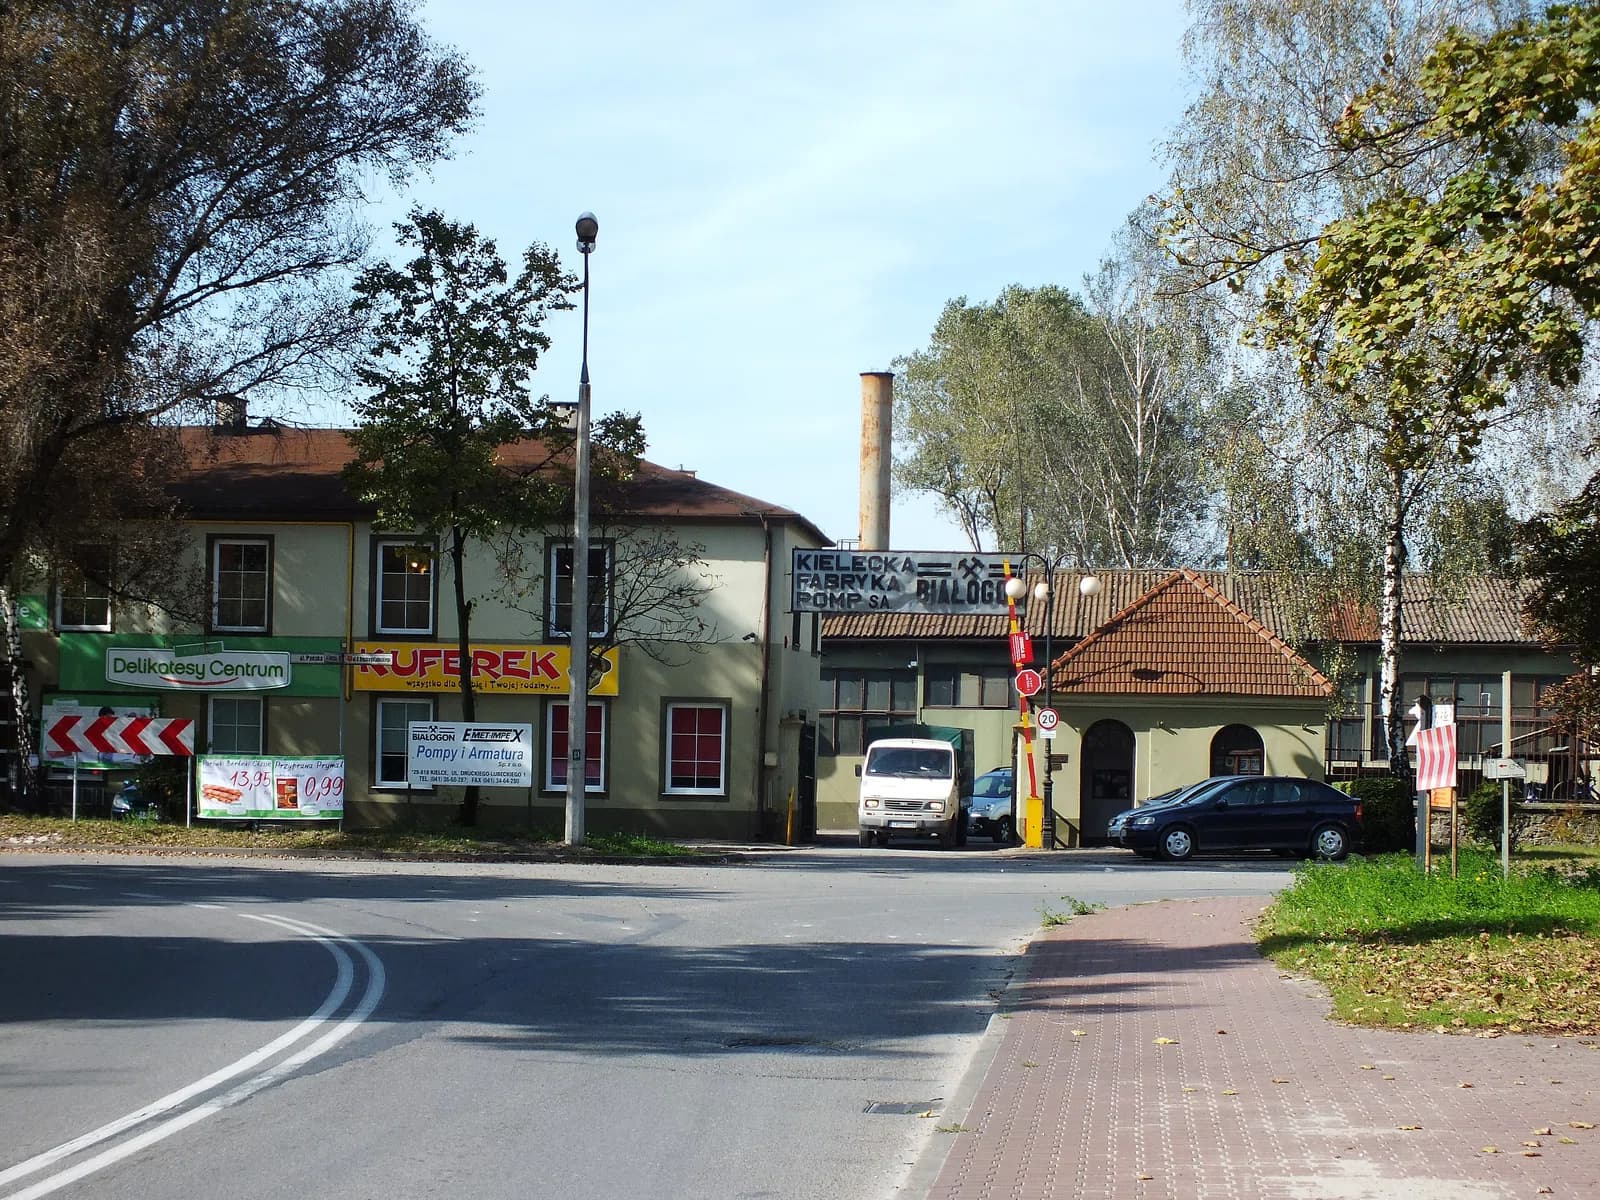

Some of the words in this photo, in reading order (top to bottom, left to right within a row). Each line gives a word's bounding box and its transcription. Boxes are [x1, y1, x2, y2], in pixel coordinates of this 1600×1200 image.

[797, 554, 914, 573] KIELECKA
[797, 573, 900, 591] FABRYKA
[797, 592, 862, 609] POMP
[916, 579, 1024, 605] BIAŁOGO
[114, 658, 205, 679] Delikatesy
[210, 660, 283, 677] Centrum
[360, 648, 560, 680] KUFEREK
[406, 680, 441, 690] wszystko
[444, 680, 456, 688] dla
[490, 681, 519, 690] Twojej
[1042, 715, 1055, 724] 20
[416, 745, 458, 761] Pompy
[461, 746, 466, 758] i
[469, 746, 524, 760] Armatura
[230, 770, 271, 791] 13,95
[304, 776, 344, 801] 0,99
